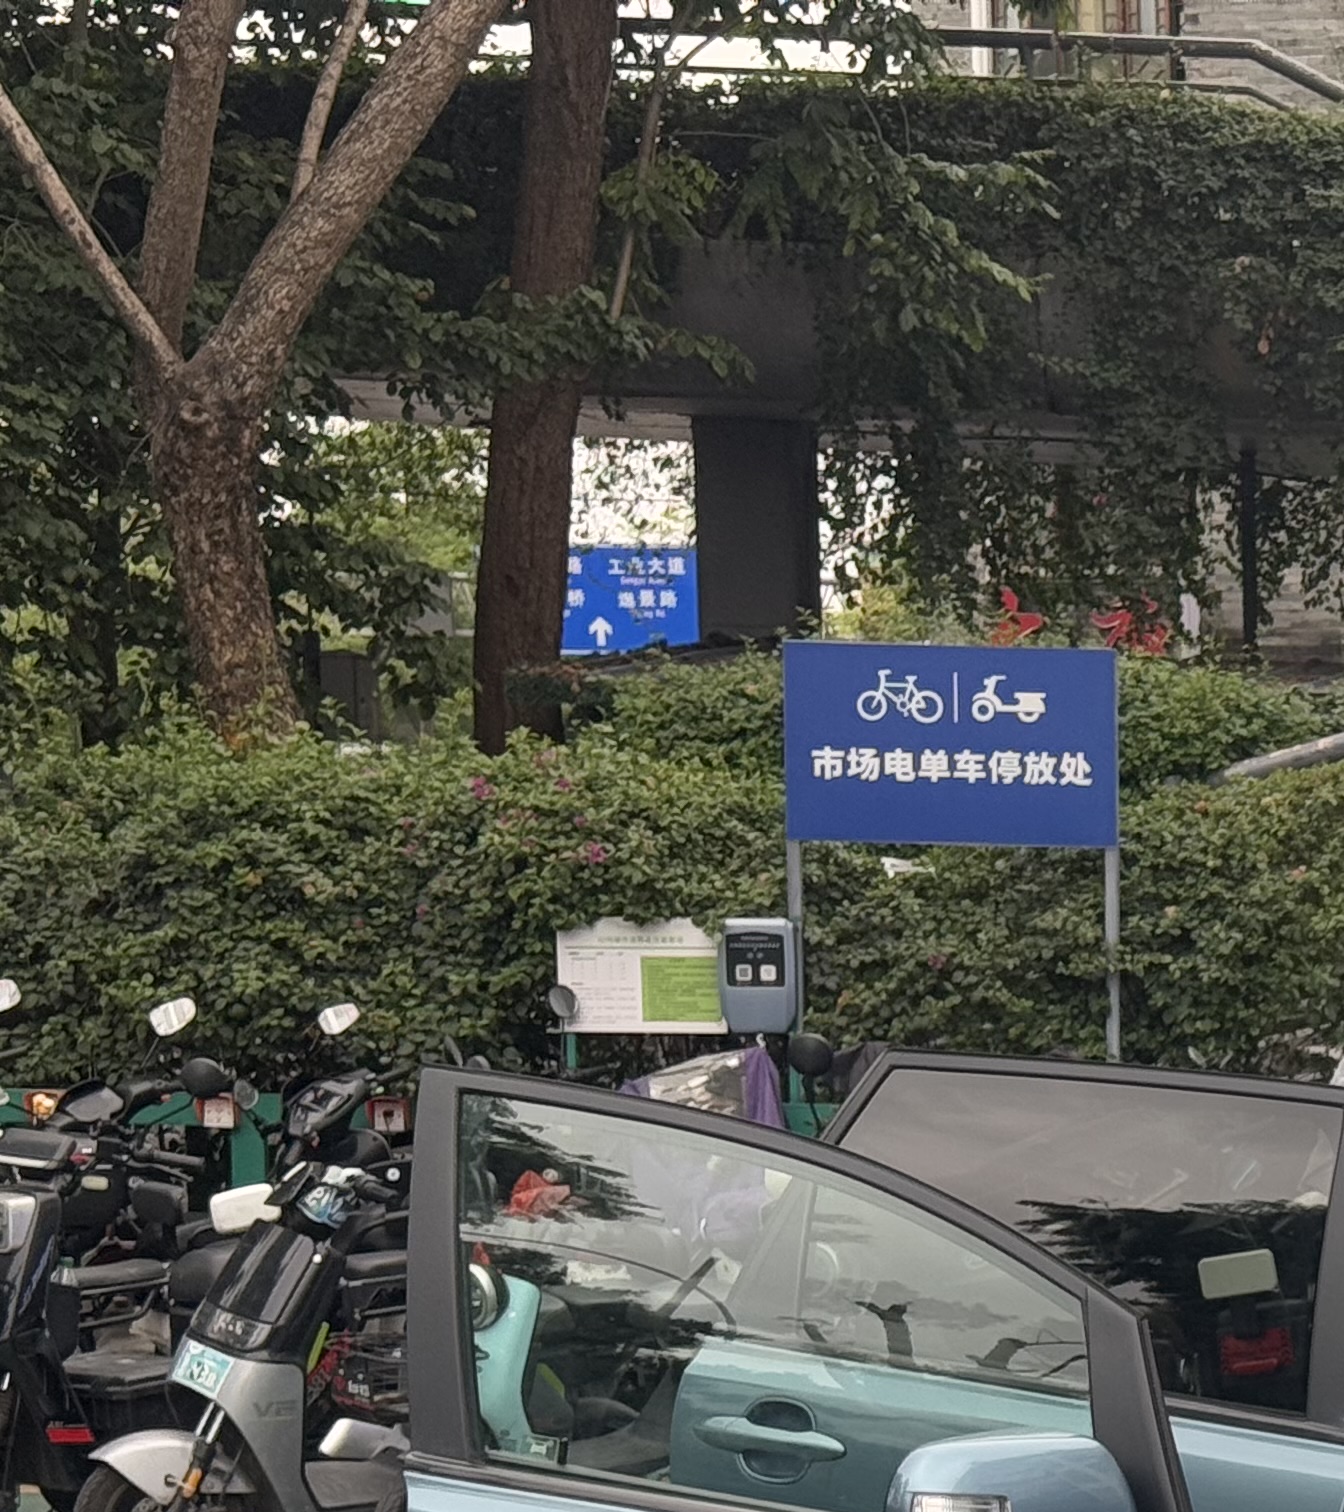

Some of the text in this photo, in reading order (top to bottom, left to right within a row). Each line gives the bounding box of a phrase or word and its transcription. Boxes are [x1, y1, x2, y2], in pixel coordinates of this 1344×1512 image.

[811, 745, 1094, 787] 市场电单车停放处
